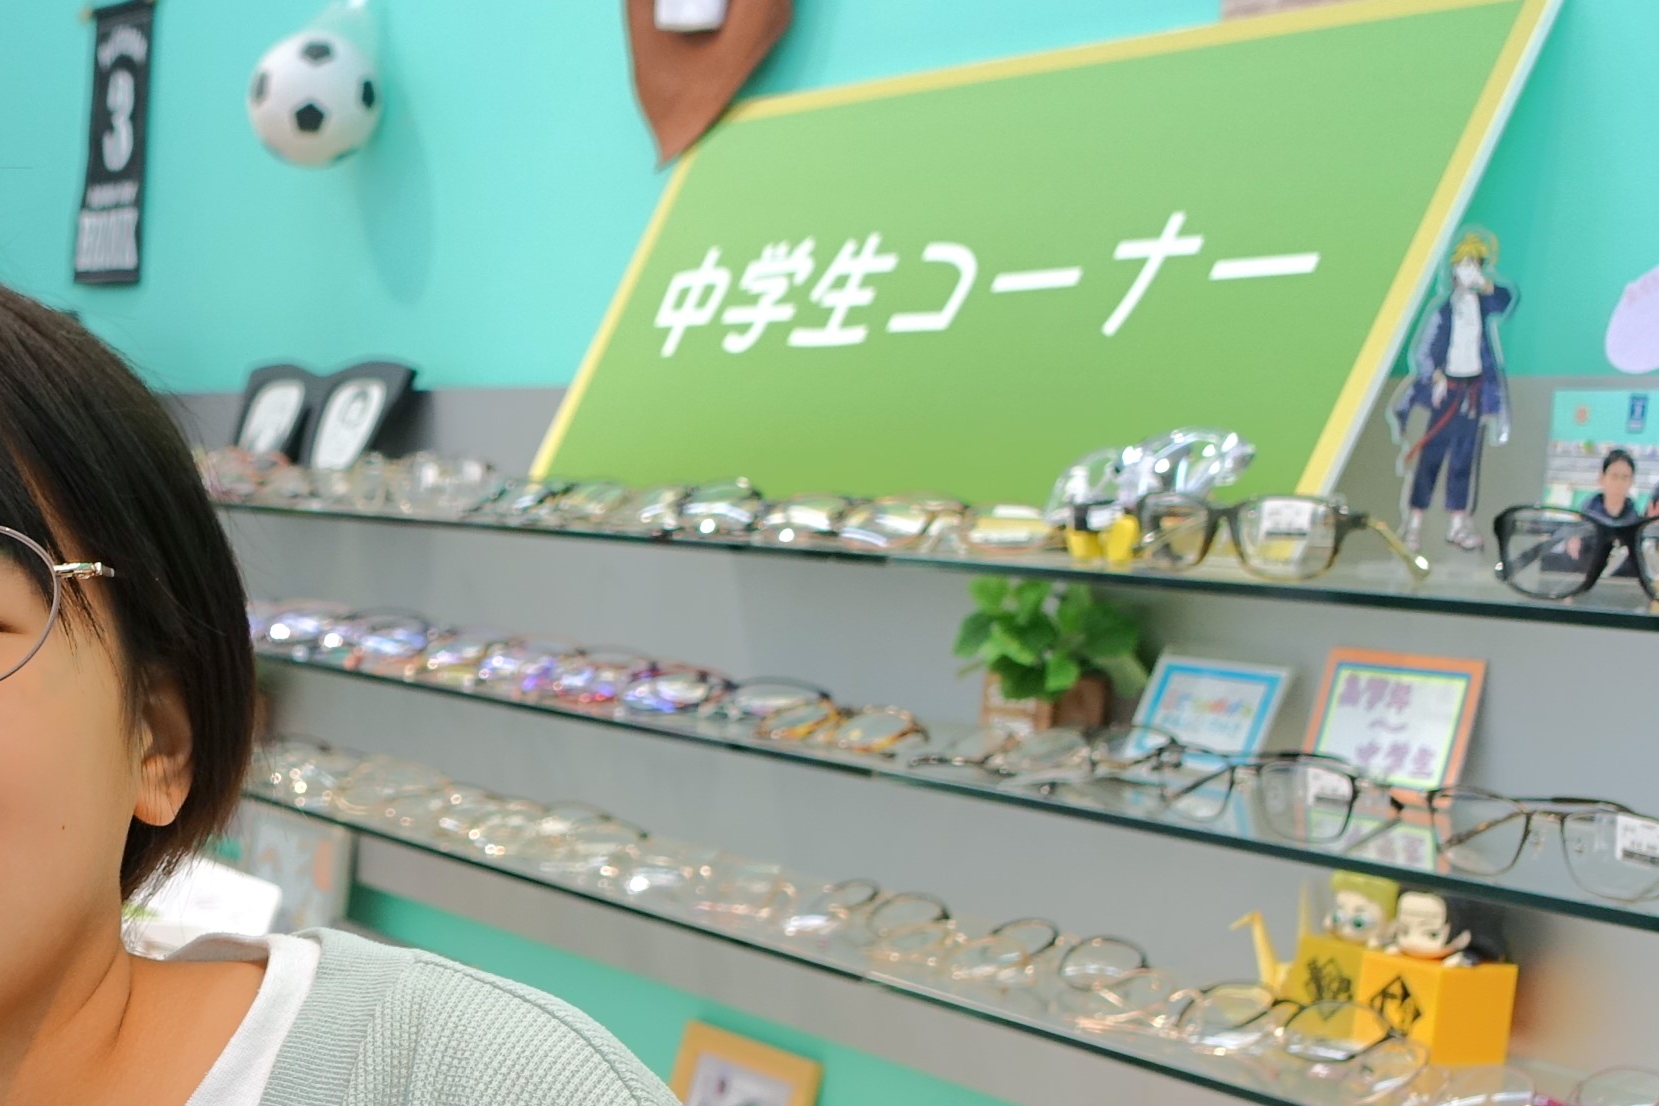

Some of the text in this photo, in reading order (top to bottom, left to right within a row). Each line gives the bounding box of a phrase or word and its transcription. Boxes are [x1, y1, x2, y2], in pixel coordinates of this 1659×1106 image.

[102, 68, 136, 173] 3
[653, 210, 1321, 358] 中学生コーナー
